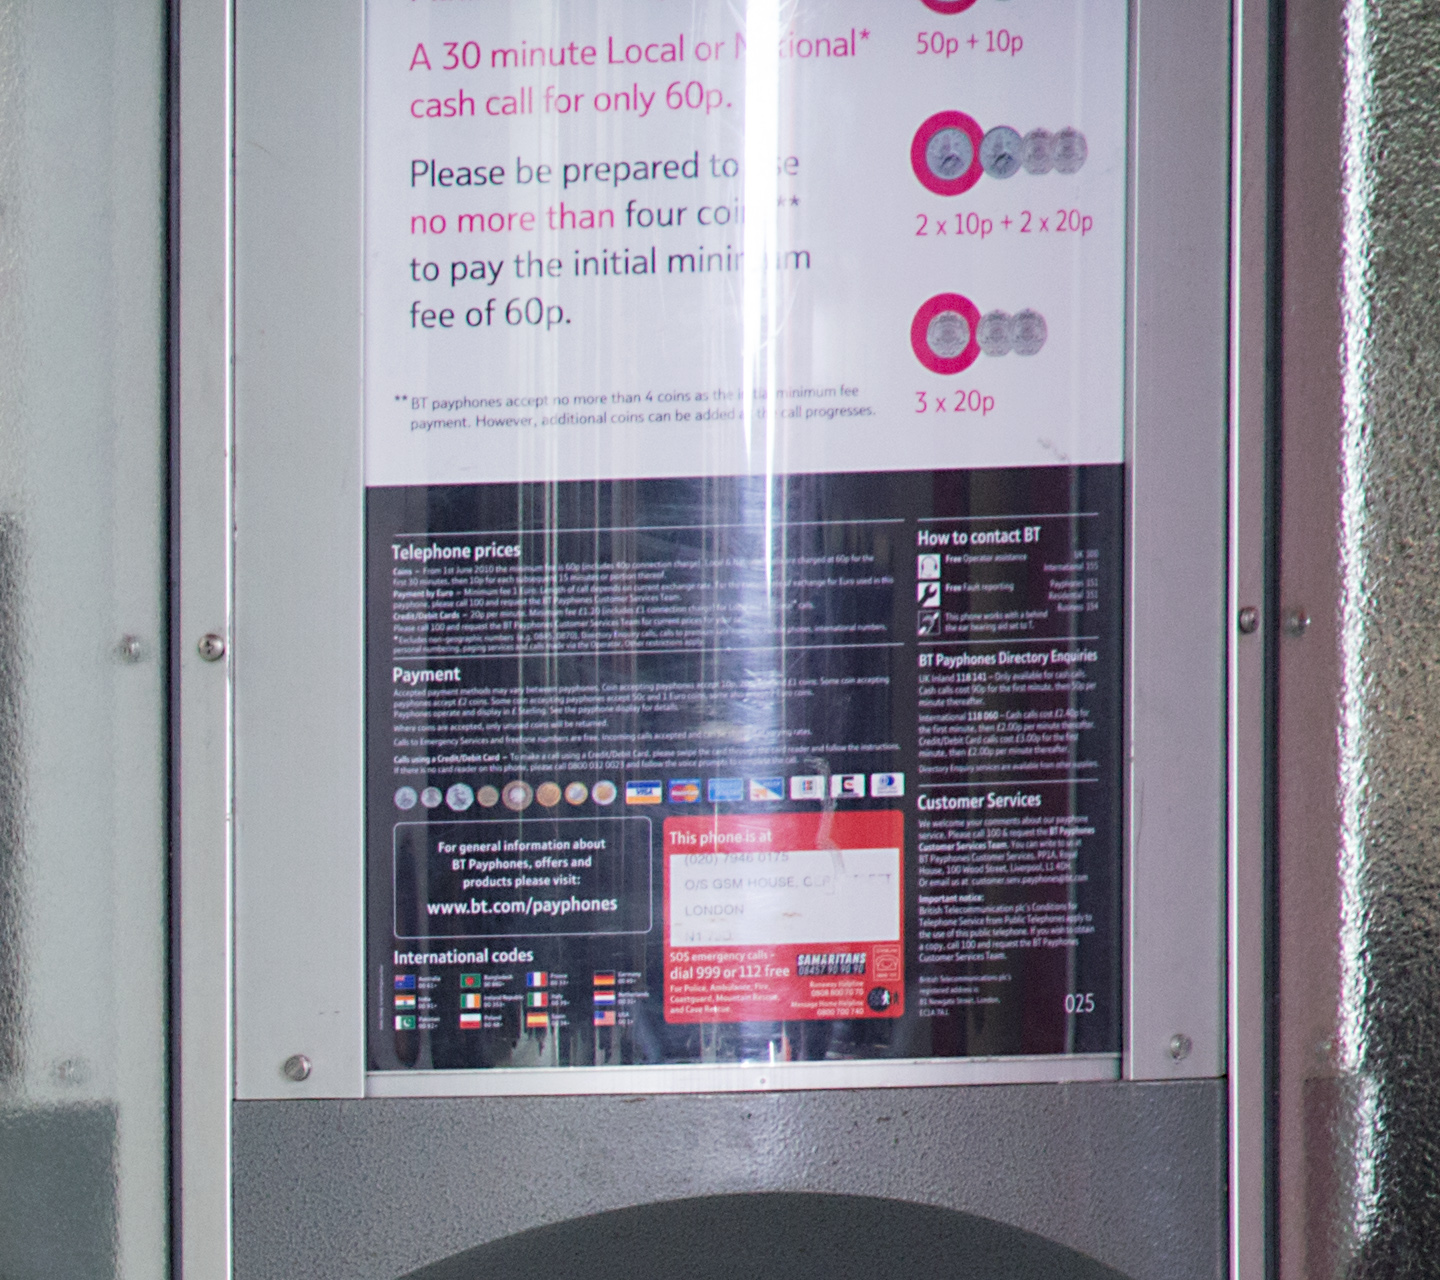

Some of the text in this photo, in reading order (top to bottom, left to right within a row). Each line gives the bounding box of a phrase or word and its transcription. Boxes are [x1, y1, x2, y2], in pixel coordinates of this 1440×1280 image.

[409, 42, 432, 72] A
[442, 40, 482, 71] 30
[491, 40, 597, 69] minute
[608, 33, 685, 65] Local
[694, 40, 726, 62] or
[916, 31, 960, 59] 50p
[984, 28, 1024, 57] 10p
[410, 80, 733, 119] cash call for only 60p.
[410, 157, 506, 189] Please
[516, 156, 553, 186] be
[562, 150, 700, 189] prepared
[709, 153, 740, 179] to
[410, 198, 688, 236] no more than four
[915, 212, 929, 237] 2
[936, 219, 947, 236] x
[954, 211, 994, 240] 10p
[1020, 210, 1033, 234] 2
[1039, 216, 1050, 232] x
[1055, 208, 1094, 237] 20p
[410, 256, 440, 283] to
[450, 255, 505, 288] pay
[513, 250, 564, 280] the
[573, 245, 657, 277] initial
[409, 297, 573, 331] fee of 60p.
[410, 383, 860, 413] BT payphones accept no more than 4 coins as the minimum fee
[915, 389, 996, 417] 3 x 20p
[410, 417, 471, 432] payment.
[475, 414, 538, 430] However,
[541, 411, 607, 427] additional
[610, 410, 645, 424] coins
[648, 411, 671, 423] can
[675, 408, 691, 422] be
[695, 407, 736, 422] added
[781, 404, 802, 419] call
[805, 404, 877, 420] progresses.
[917, 525, 1042, 546] How to contact BT
[391, 541, 522, 563] Telephone prices
[918, 649, 1098, 669] BT Payphones Directory Enquiries
[392, 666, 462, 686] Payment
[917, 791, 1042, 812] Customer Services
[437, 838, 606, 855] For general information about
[669, 829, 773, 847] This phone is at
[451, 855, 593, 872] BT Payphones, offers and
[684, 853, 719, 865] (020)
[463, 873, 581, 888] products please visit:
[426, 896, 618, 915] www.bt.com/payphones
[684, 904, 745, 916] LONDON
[393, 946, 535, 965] International codes
[670, 949, 769, 963] SOS emergency calls
[798, 952, 867, 966] SAMARITANS
[670, 967, 694, 980] dial
[695, 966, 721, 980] 999
[723, 967, 737, 979] or
[739, 965, 762, 978] 112
[764, 964, 791, 977] free
[670, 984, 683, 993] For
[670, 1004, 684, 1014] and
[685, 1004, 706, 1014] Cave
[1064, 992, 1096, 1013] 025
